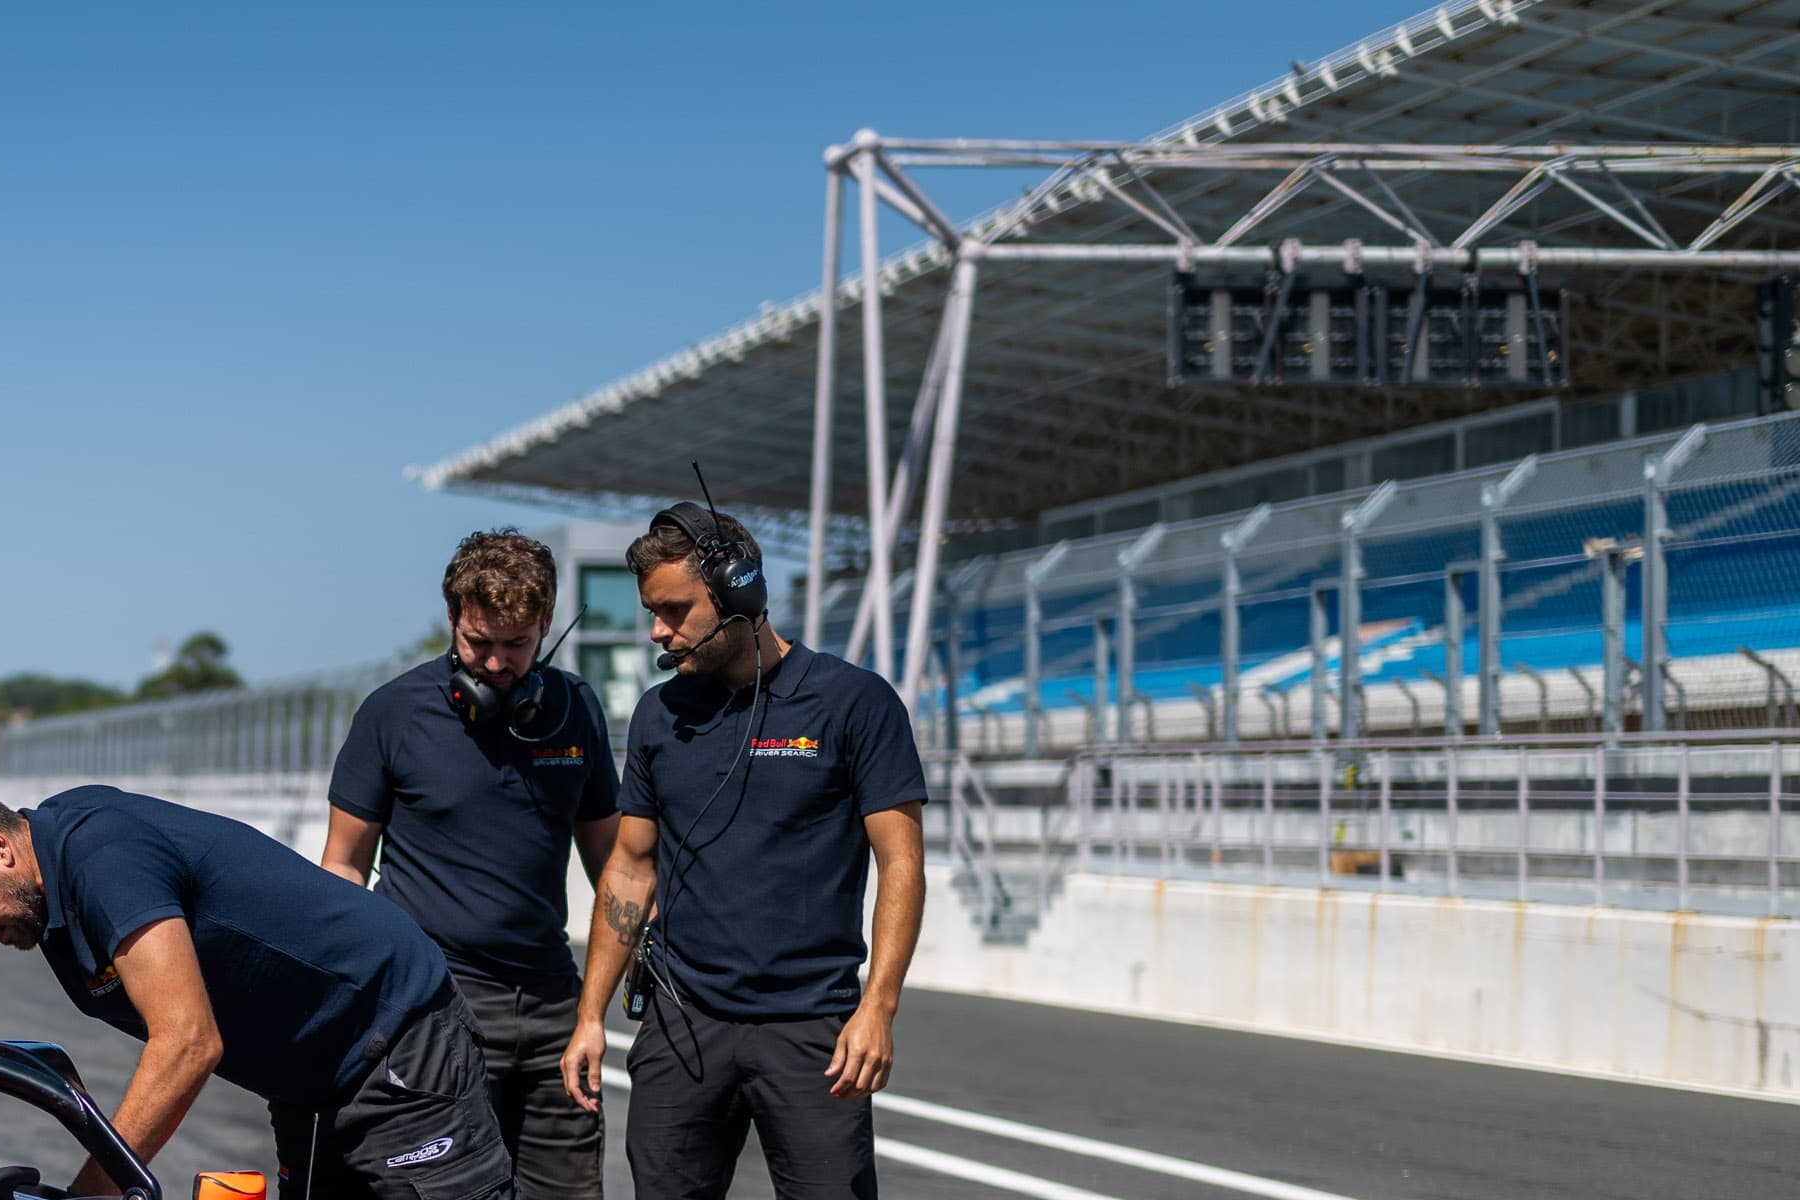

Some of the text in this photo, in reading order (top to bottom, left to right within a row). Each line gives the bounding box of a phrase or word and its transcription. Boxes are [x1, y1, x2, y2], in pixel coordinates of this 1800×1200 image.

[751, 738, 787, 748] Red Bull
[780, 750, 818, 758] SEARCH
